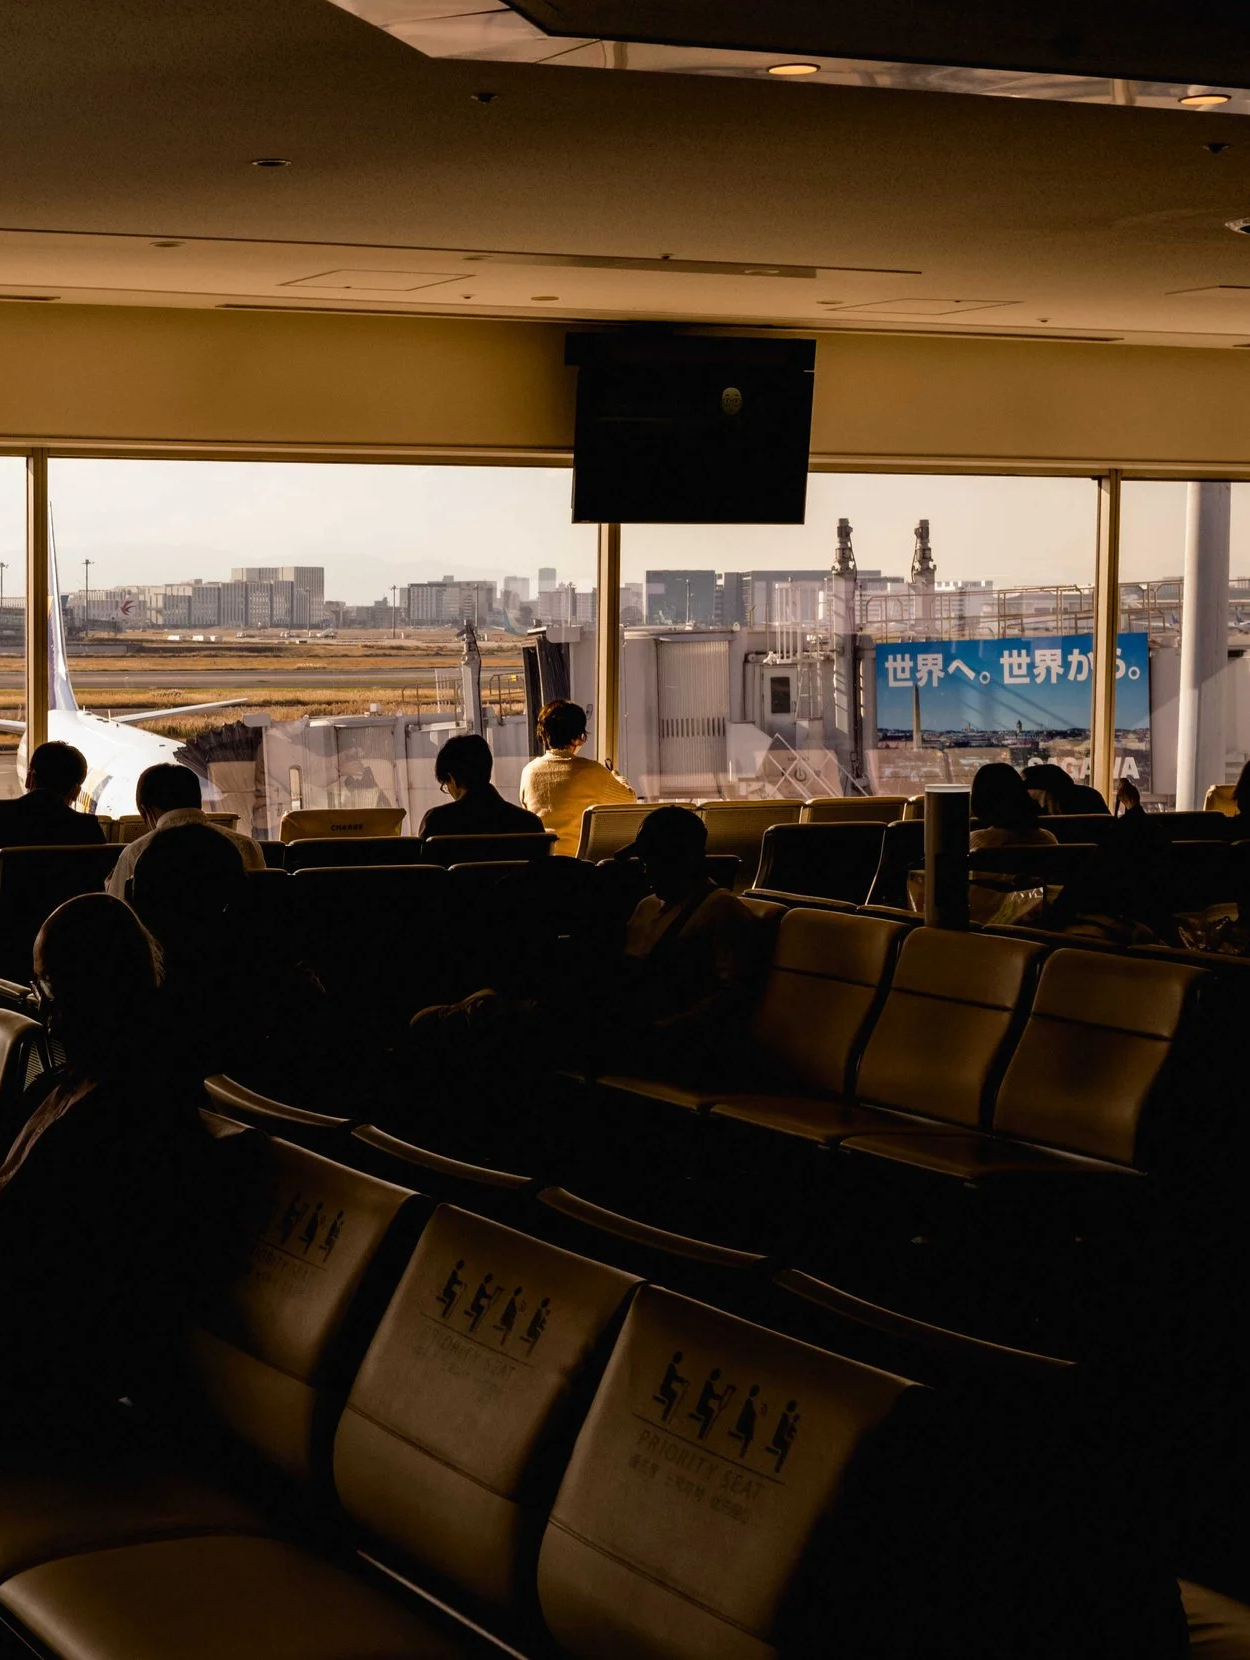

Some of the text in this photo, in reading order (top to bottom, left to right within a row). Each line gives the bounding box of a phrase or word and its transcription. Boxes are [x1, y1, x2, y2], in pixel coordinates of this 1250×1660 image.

[330, 823, 363, 832] CHARGE
[637, 1429, 765, 1502] PRIORITY SEAT
